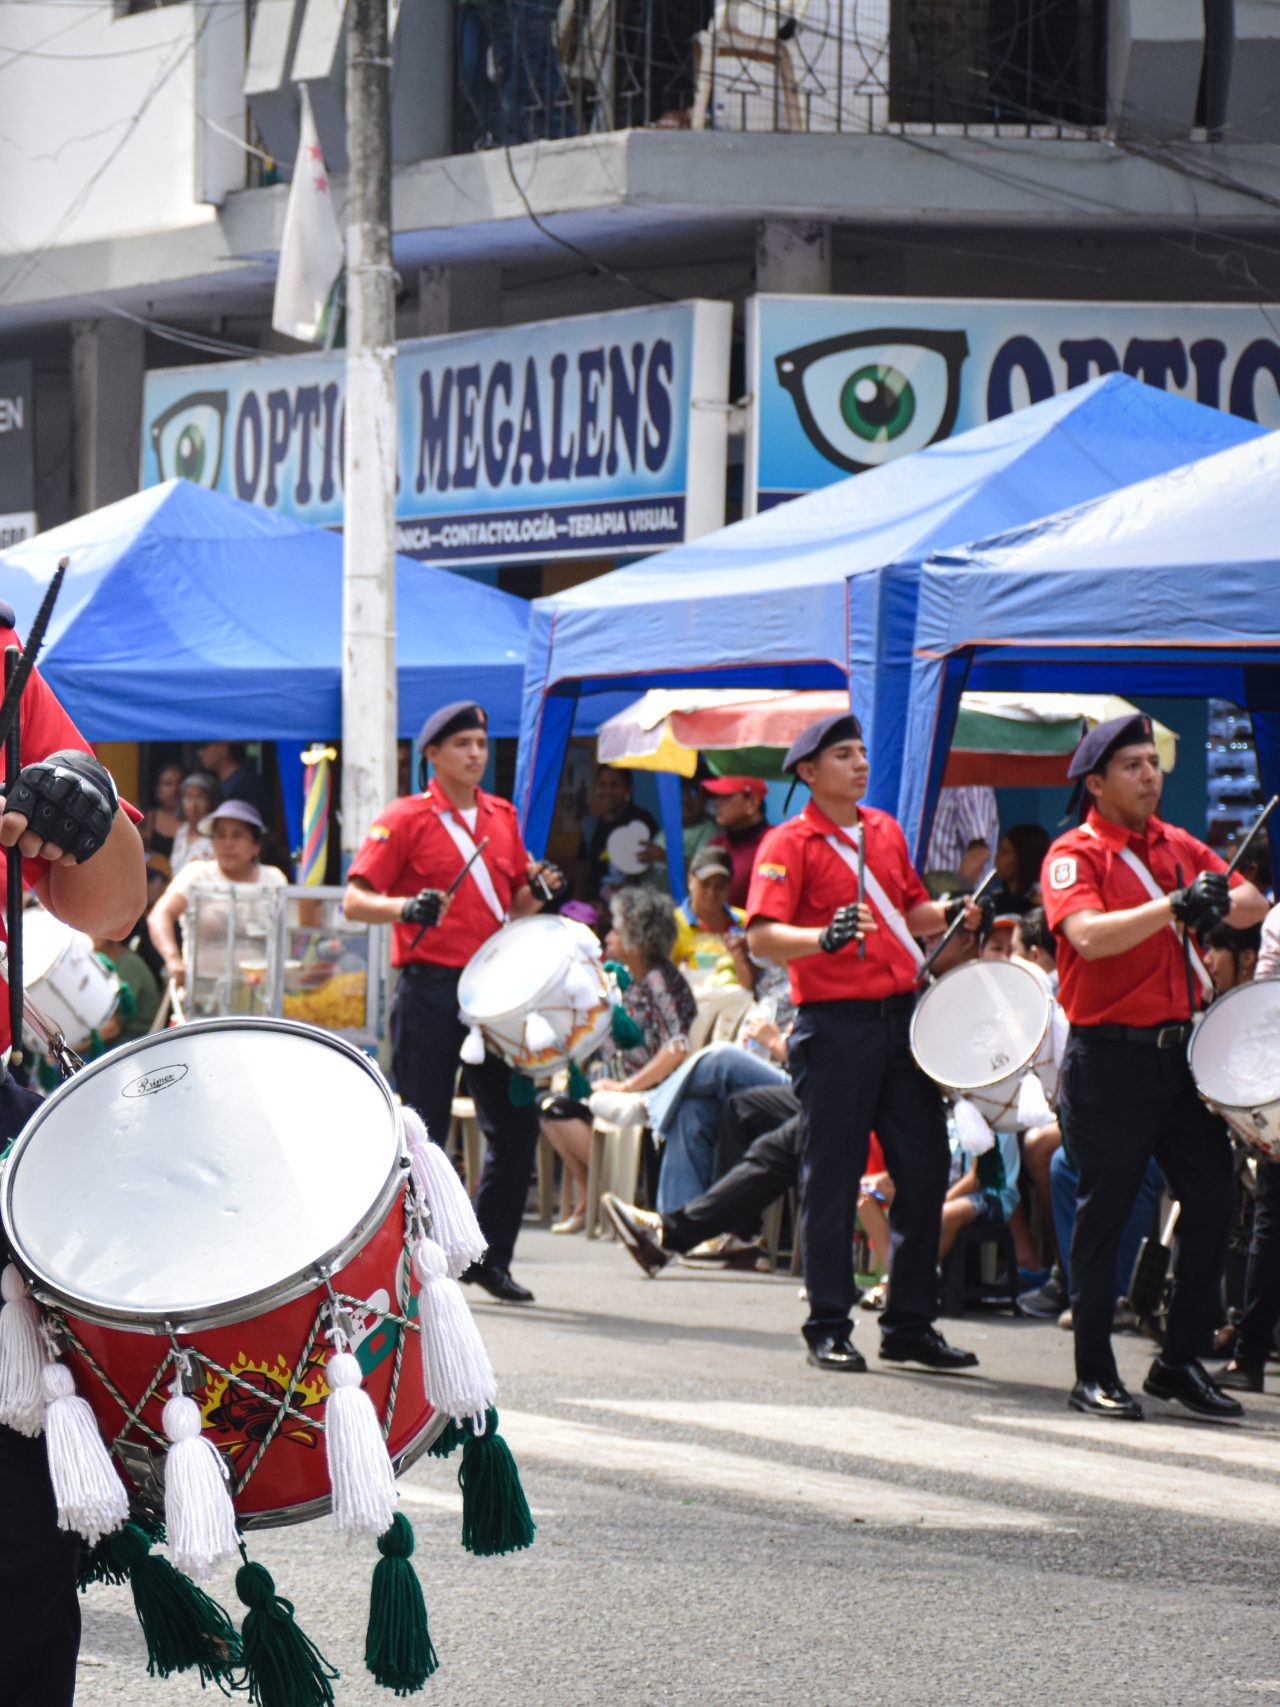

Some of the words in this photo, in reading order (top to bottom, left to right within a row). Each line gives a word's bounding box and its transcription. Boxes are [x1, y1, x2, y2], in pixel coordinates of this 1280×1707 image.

[235, 381, 400, 508] OPTI
[416, 338, 674, 494] MEGALENS
[627, 506, 678, 533] VISUAL
